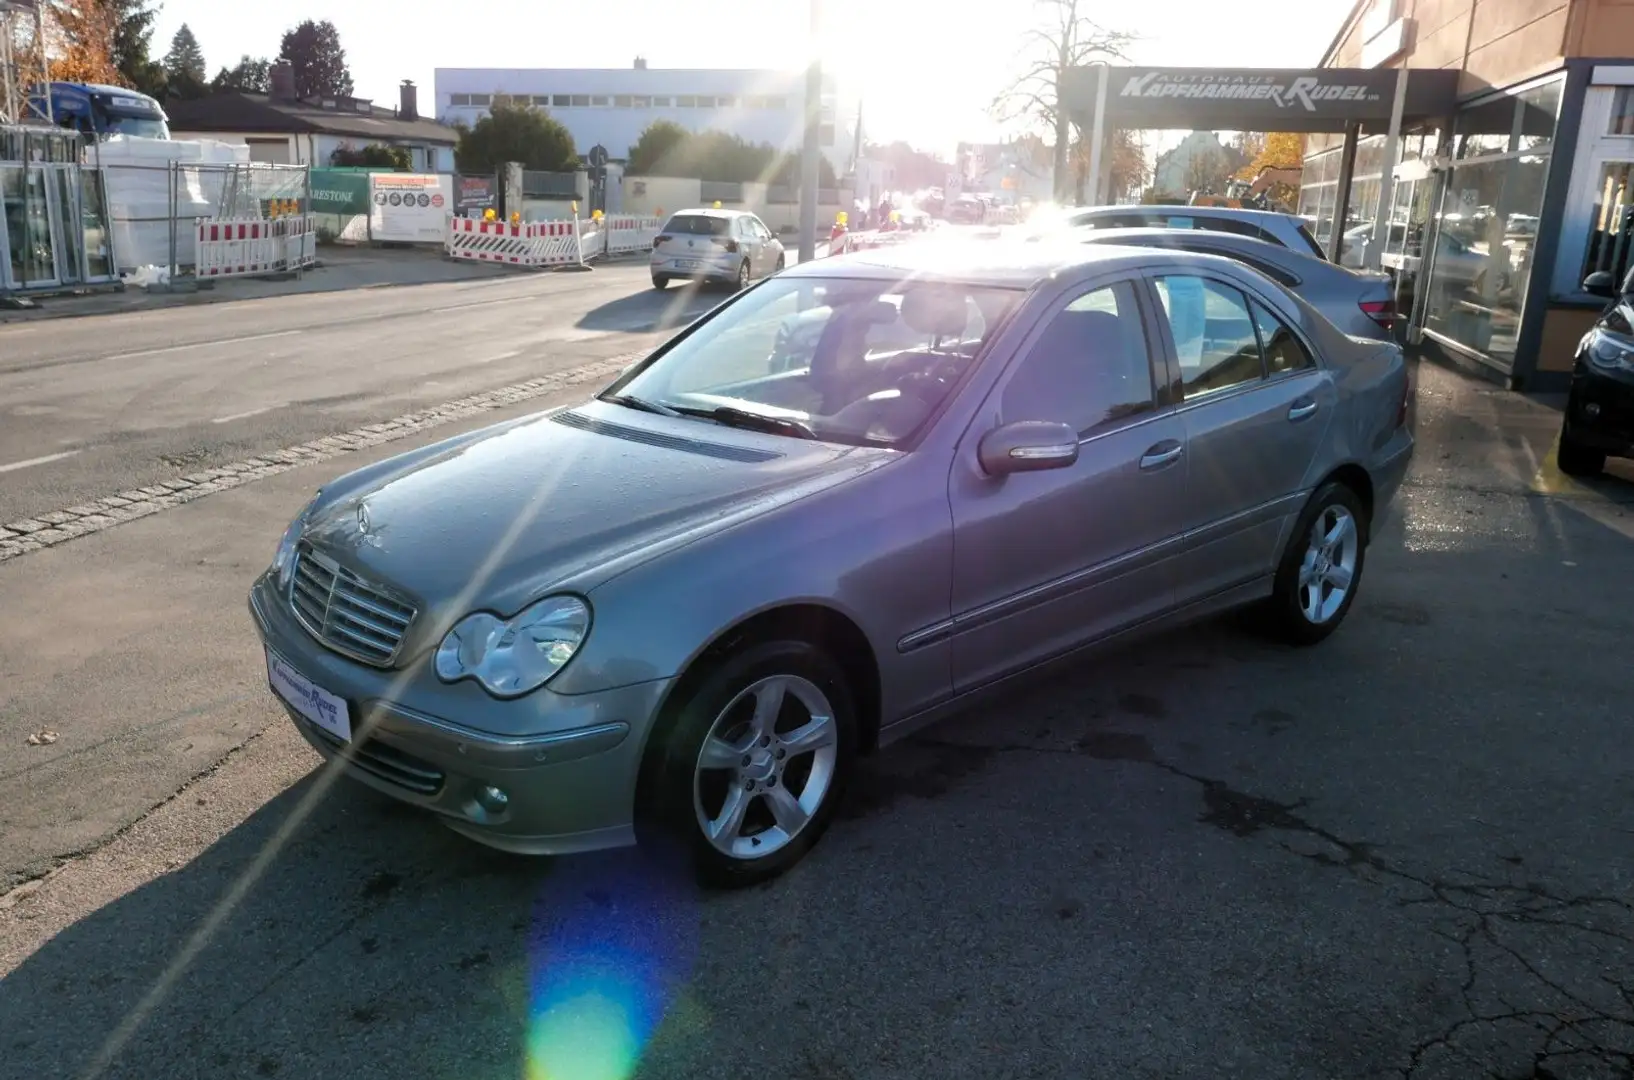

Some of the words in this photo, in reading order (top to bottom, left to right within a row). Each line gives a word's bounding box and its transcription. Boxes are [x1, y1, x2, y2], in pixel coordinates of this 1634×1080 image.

[1119, 71, 1284, 107] KAPFHAMMER
[1283, 77, 1368, 111] RUDEL
[1157, 75, 1276, 84] AUTOHAUS
